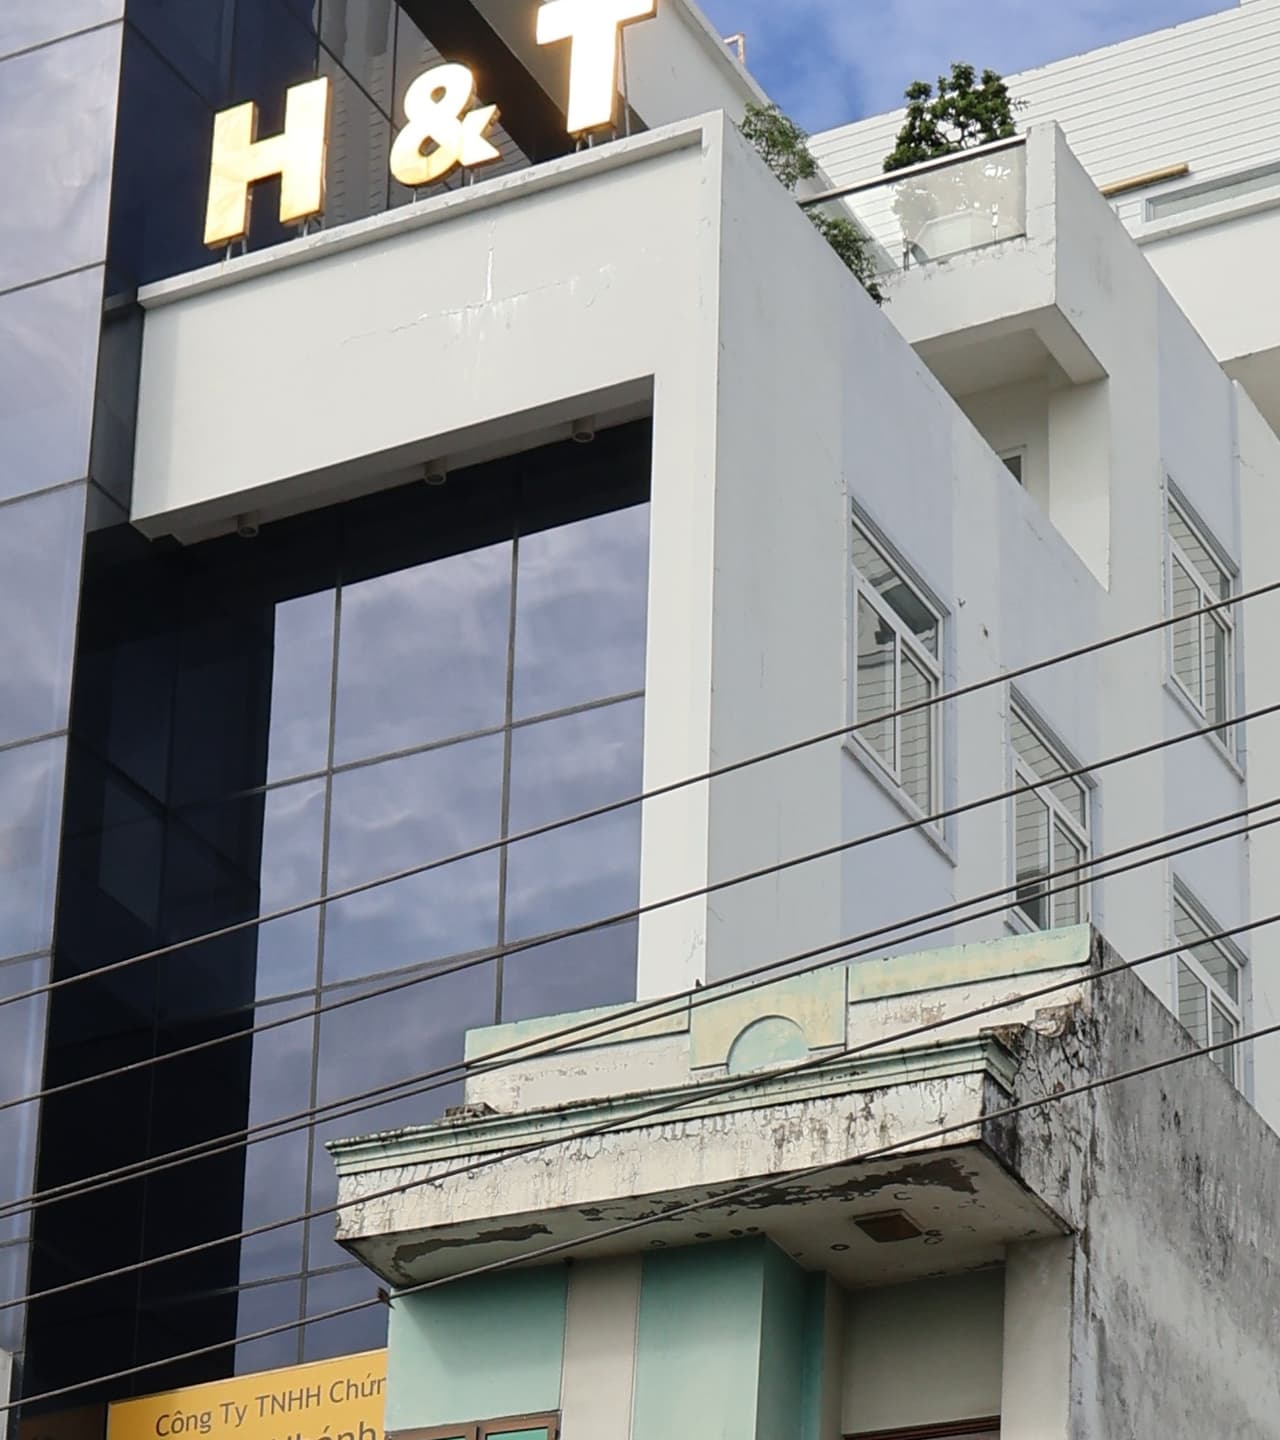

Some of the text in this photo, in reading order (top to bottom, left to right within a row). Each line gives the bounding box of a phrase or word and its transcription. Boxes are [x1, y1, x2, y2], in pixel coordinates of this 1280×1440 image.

[203, 76, 331, 248] H
[389, 62, 502, 187] &
[156, 1410, 212, 1437] Công
[220, 1402, 248, 1427] Ty
[254, 1385, 321, 1417] TNHH
